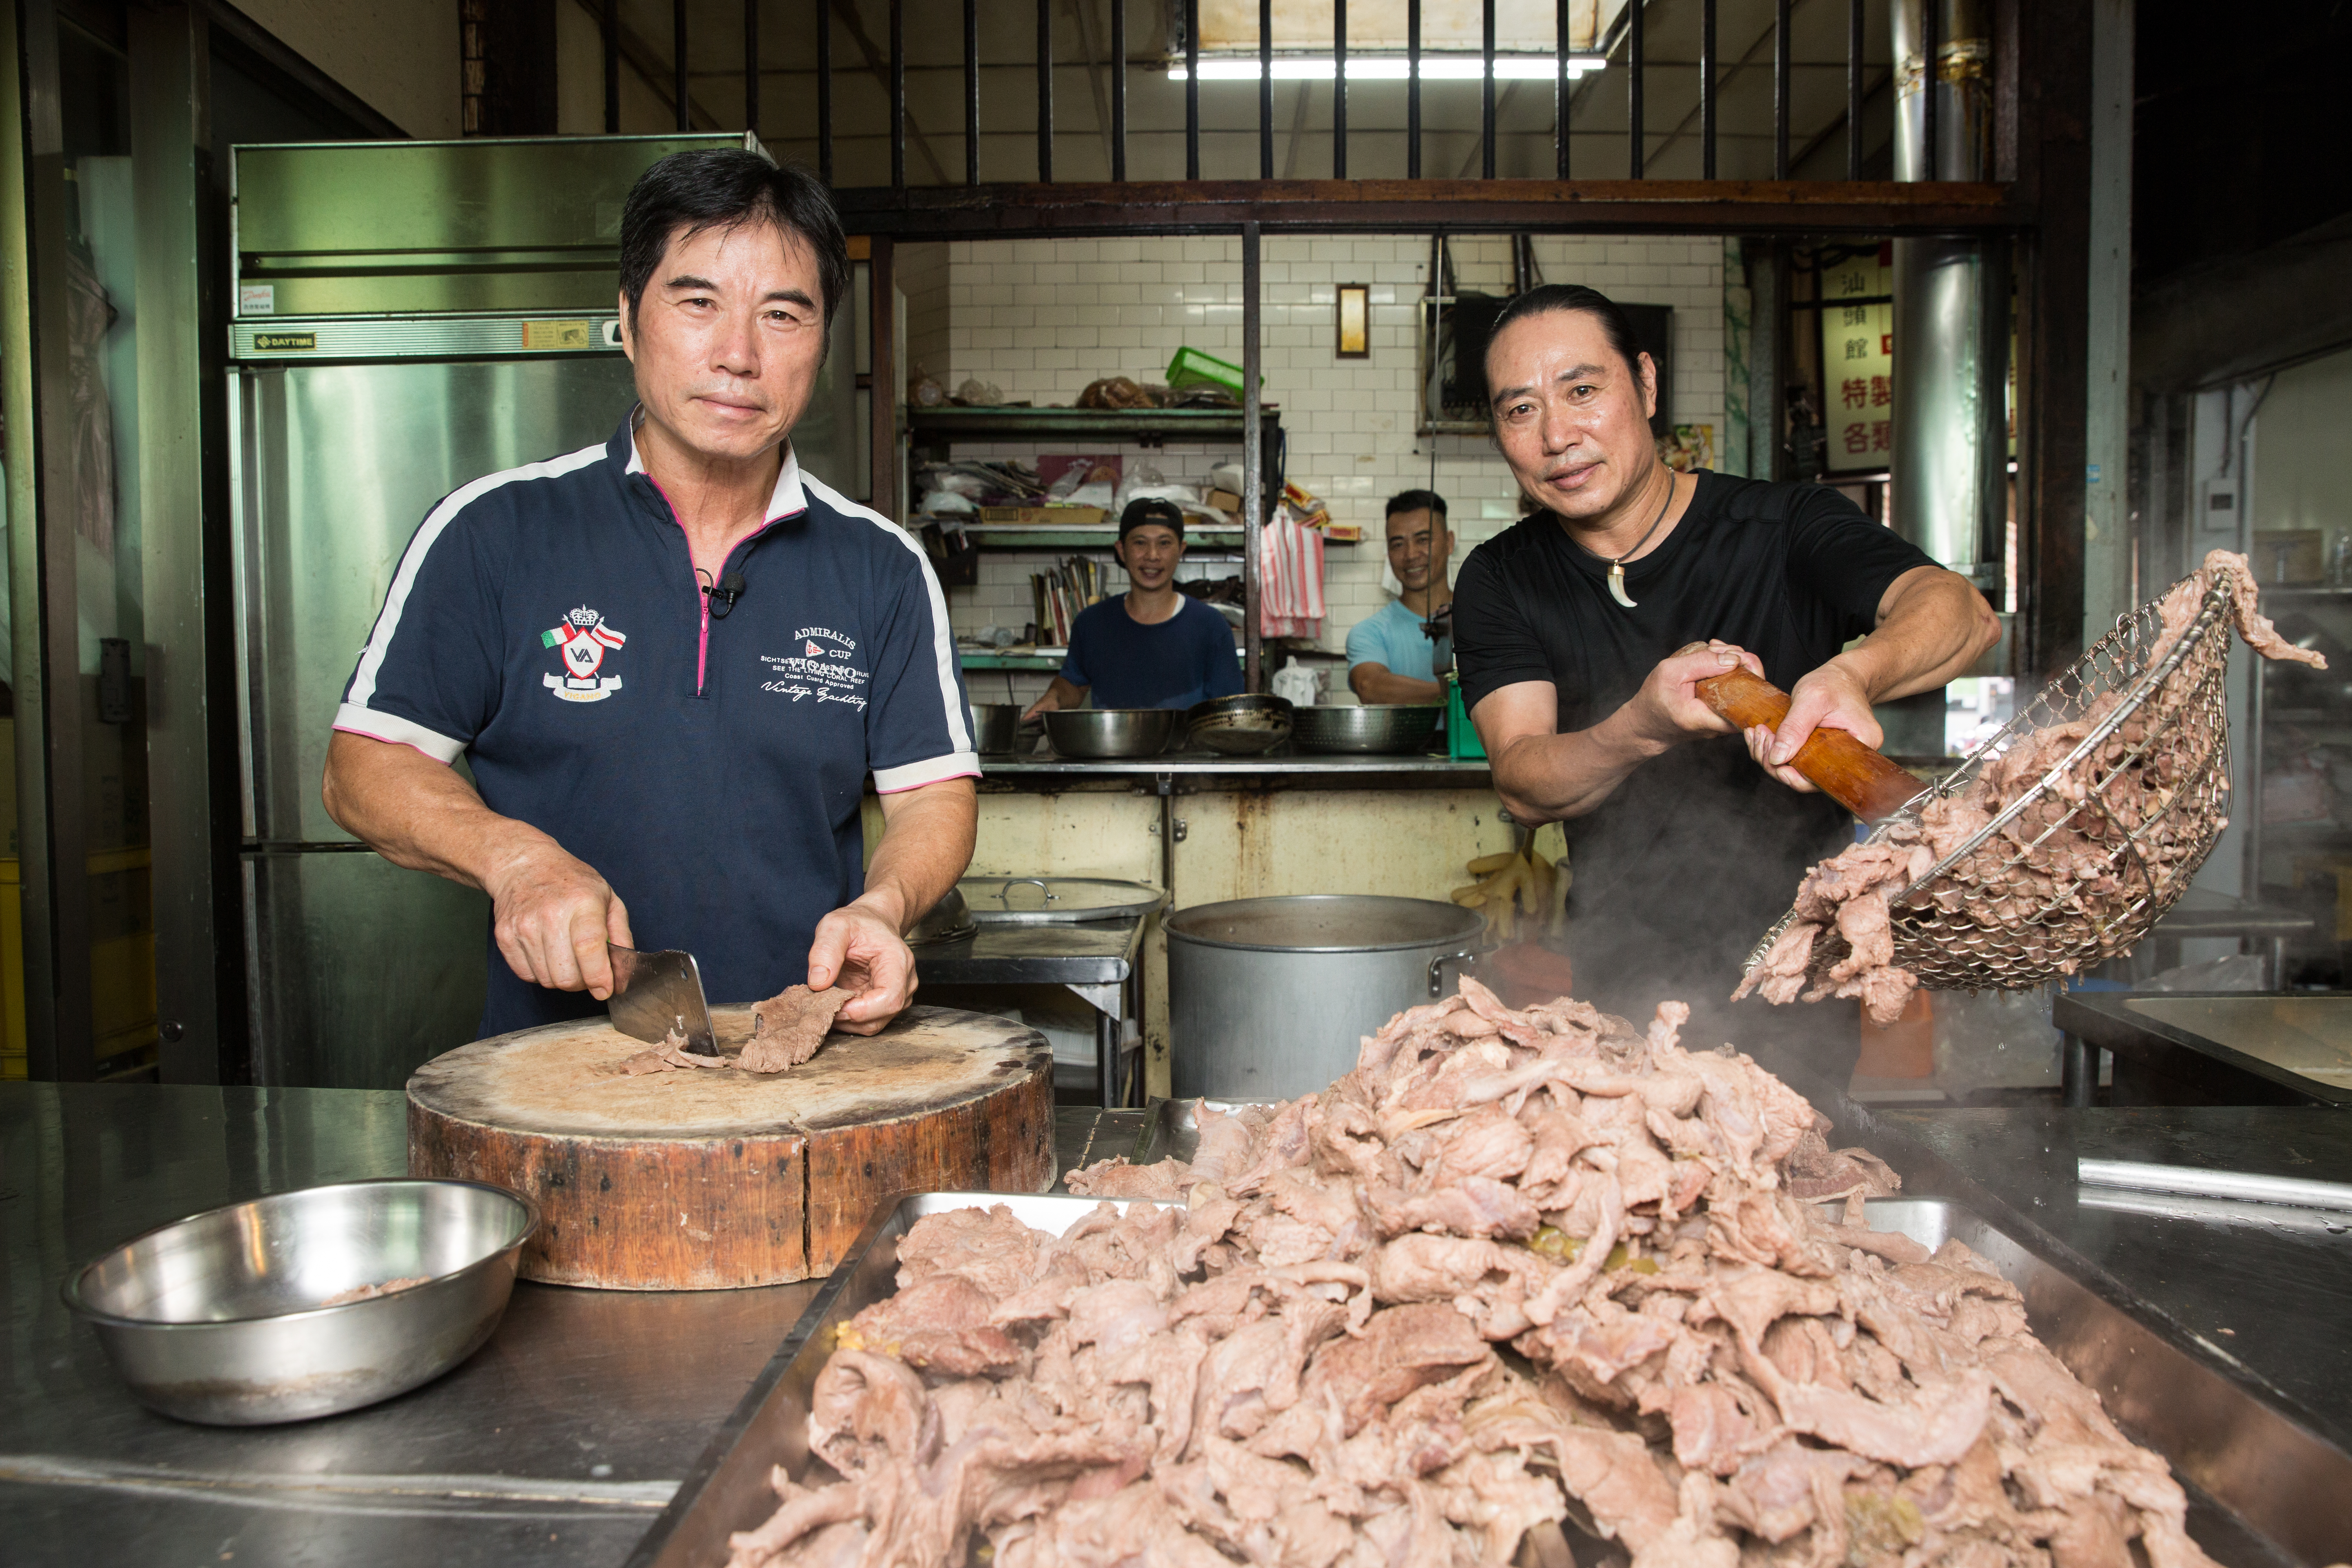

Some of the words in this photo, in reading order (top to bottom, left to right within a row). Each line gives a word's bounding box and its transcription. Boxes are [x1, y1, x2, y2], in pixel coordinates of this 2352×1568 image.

[795, 627, 856, 650] ADMIRALIS
[570, 648, 594, 663] VA
[829, 649, 851, 659] CUP
[804, 668, 824, 677] LIVING
[827, 673, 848, 682] CORAL
[825, 679, 854, 689] Approved
[564, 691, 601, 701] VIGANO
[761, 681, 813, 702] Vintage
[817, 687, 867, 712] Yachting
